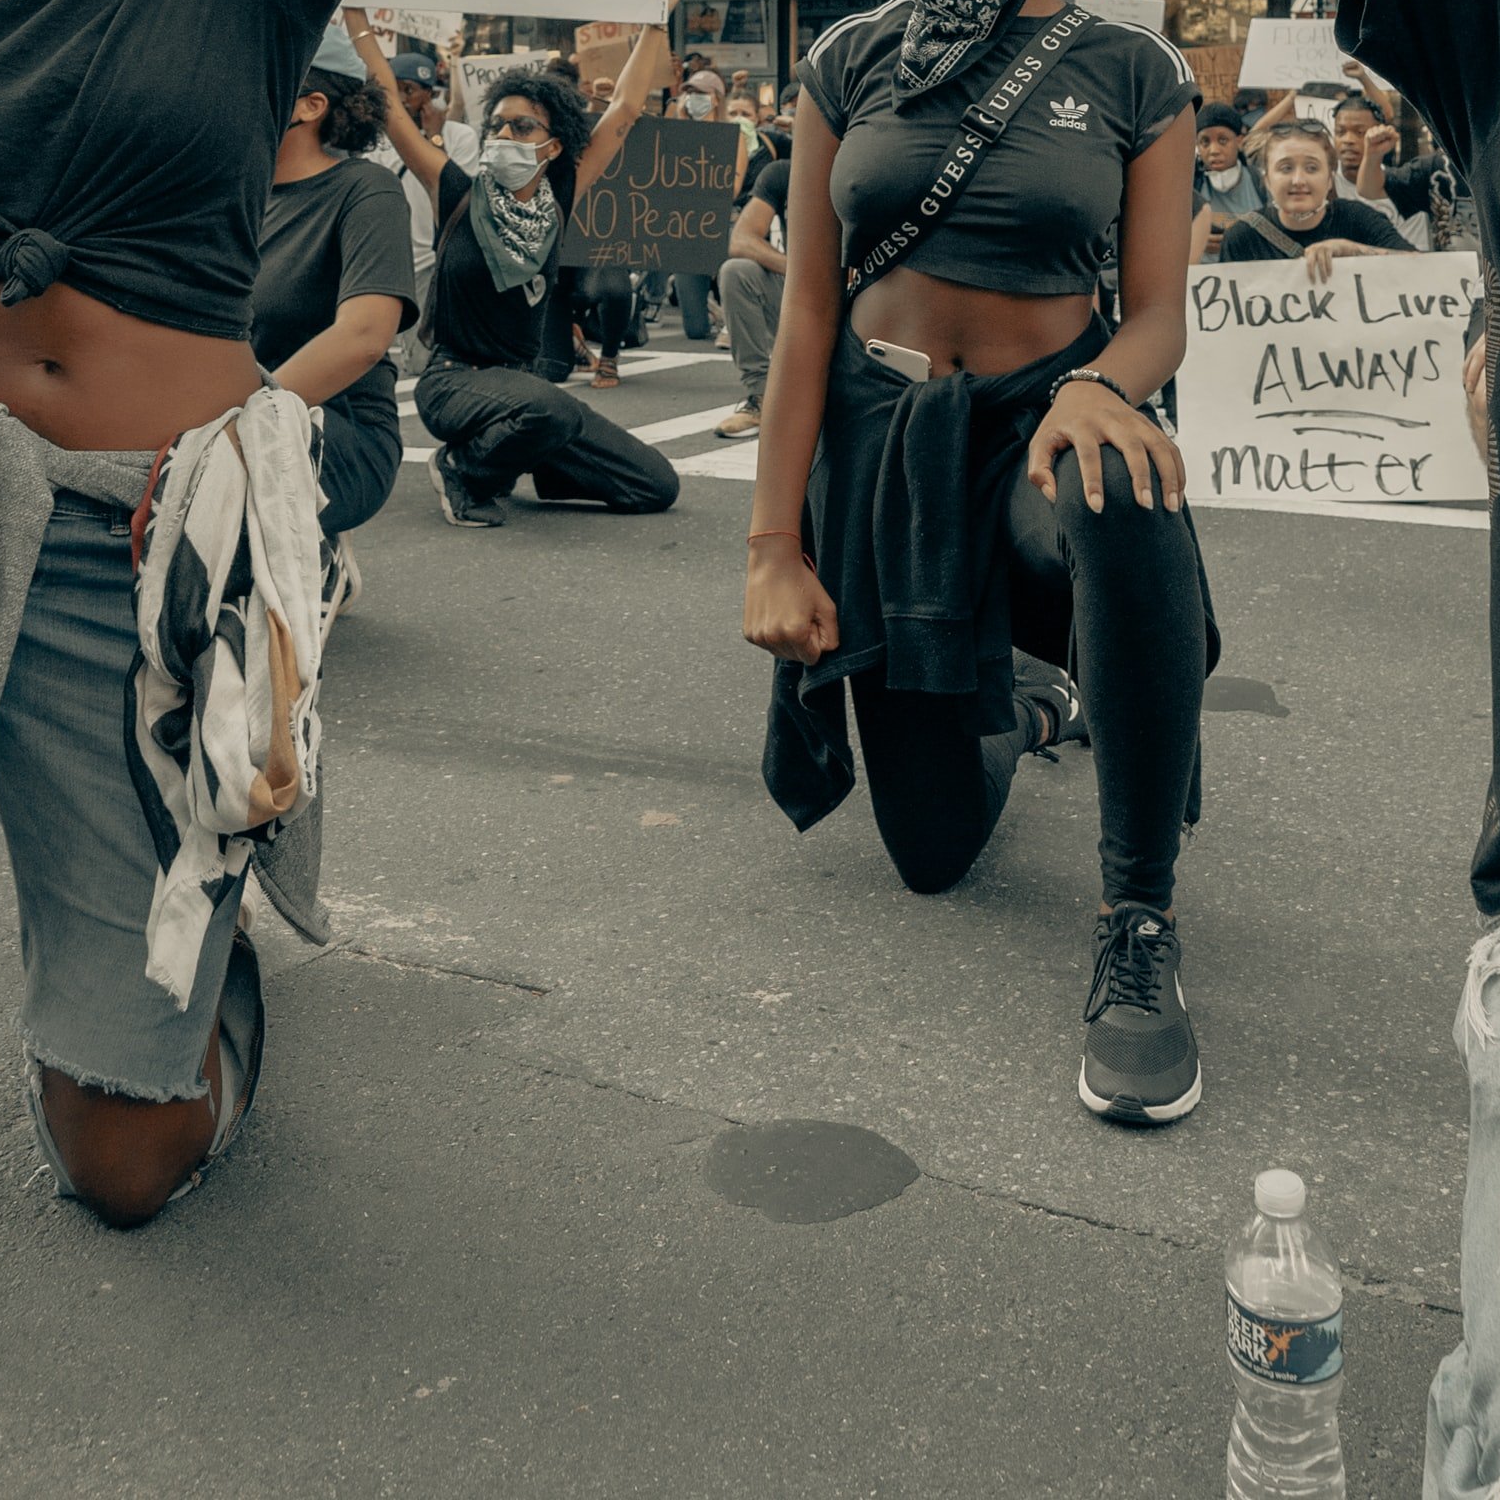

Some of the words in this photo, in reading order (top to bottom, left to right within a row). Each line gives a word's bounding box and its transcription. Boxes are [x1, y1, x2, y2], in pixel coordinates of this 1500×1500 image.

[1049, 117, 1087, 131] adidas
[628, 129, 733, 191] Justice
[920, 132, 985, 216] GUESS
[627, 191, 722, 239] Peace
[588, 240, 662, 268] #BLM
[864, 220, 920, 275] GUESS
[1191, 275, 1338, 332] Black
[1253, 339, 1442, 405] ALWAYS
[1228, 1298, 1268, 1347] DEER
[1228, 1317, 1271, 1369] PARK
[1275, 1371, 1298, 1382] water
